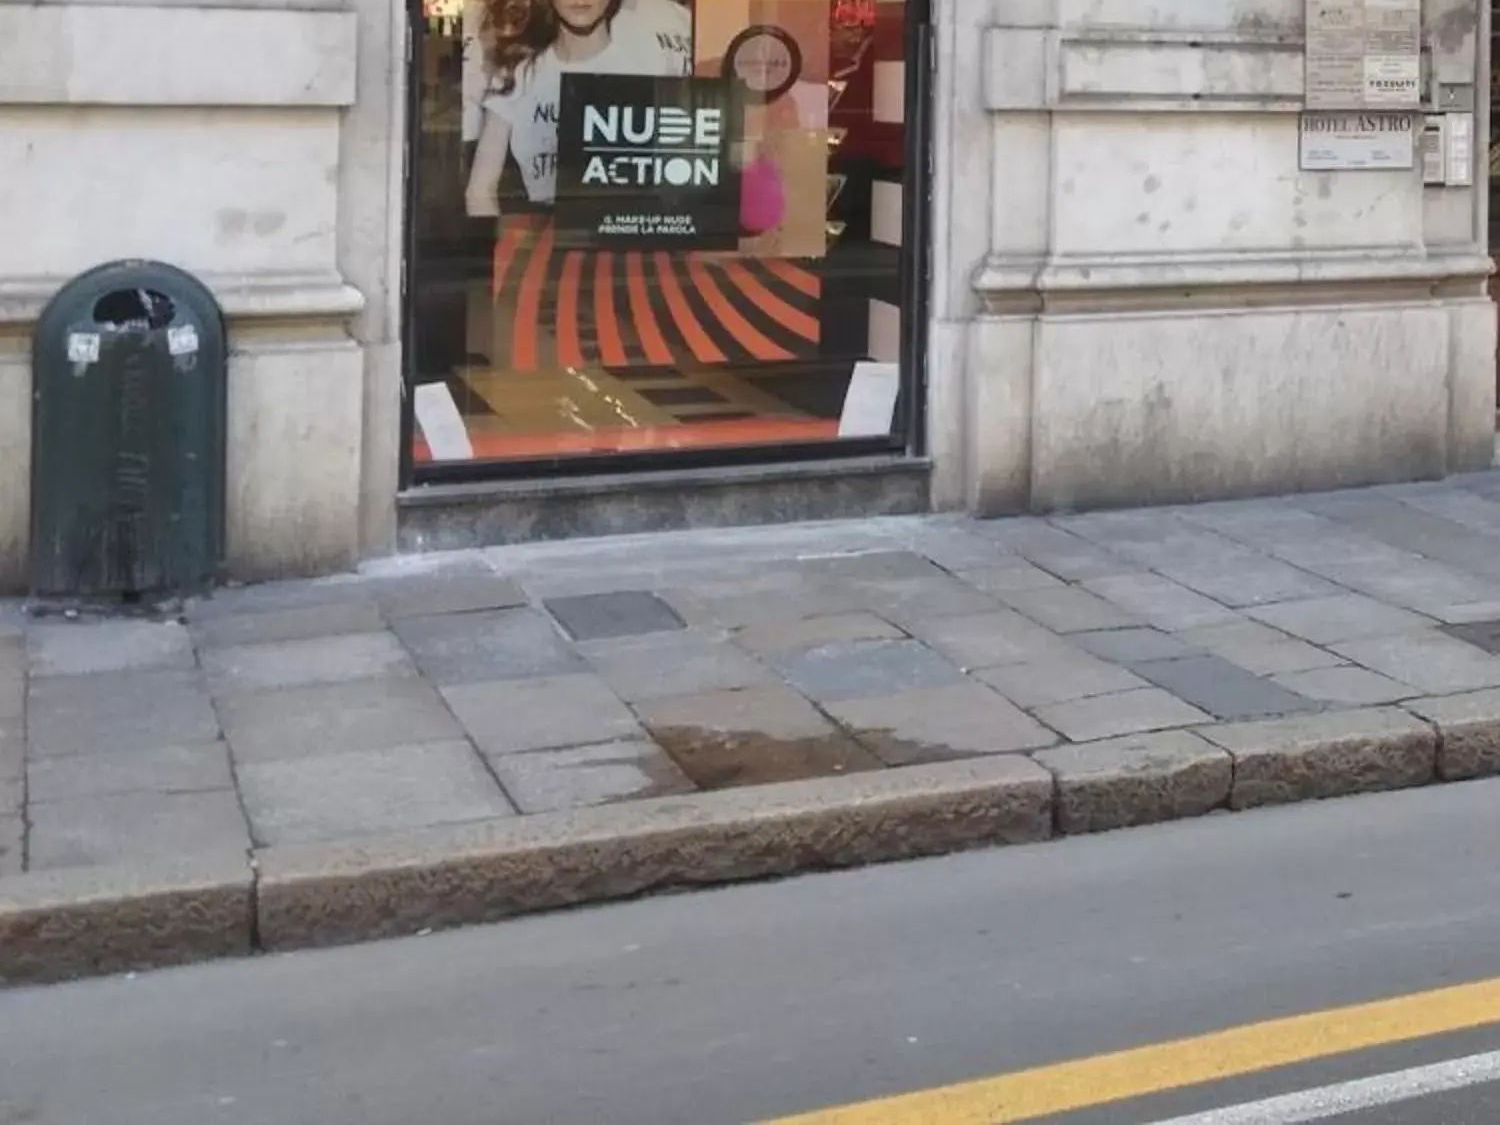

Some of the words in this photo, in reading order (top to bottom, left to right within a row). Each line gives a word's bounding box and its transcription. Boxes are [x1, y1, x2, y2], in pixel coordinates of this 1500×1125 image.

[582, 104, 721, 145] NUDE
[1304, 116, 1351, 132] HOTEL
[1356, 114, 1412, 132] ASTRO
[581, 156, 720, 186] ACTION
